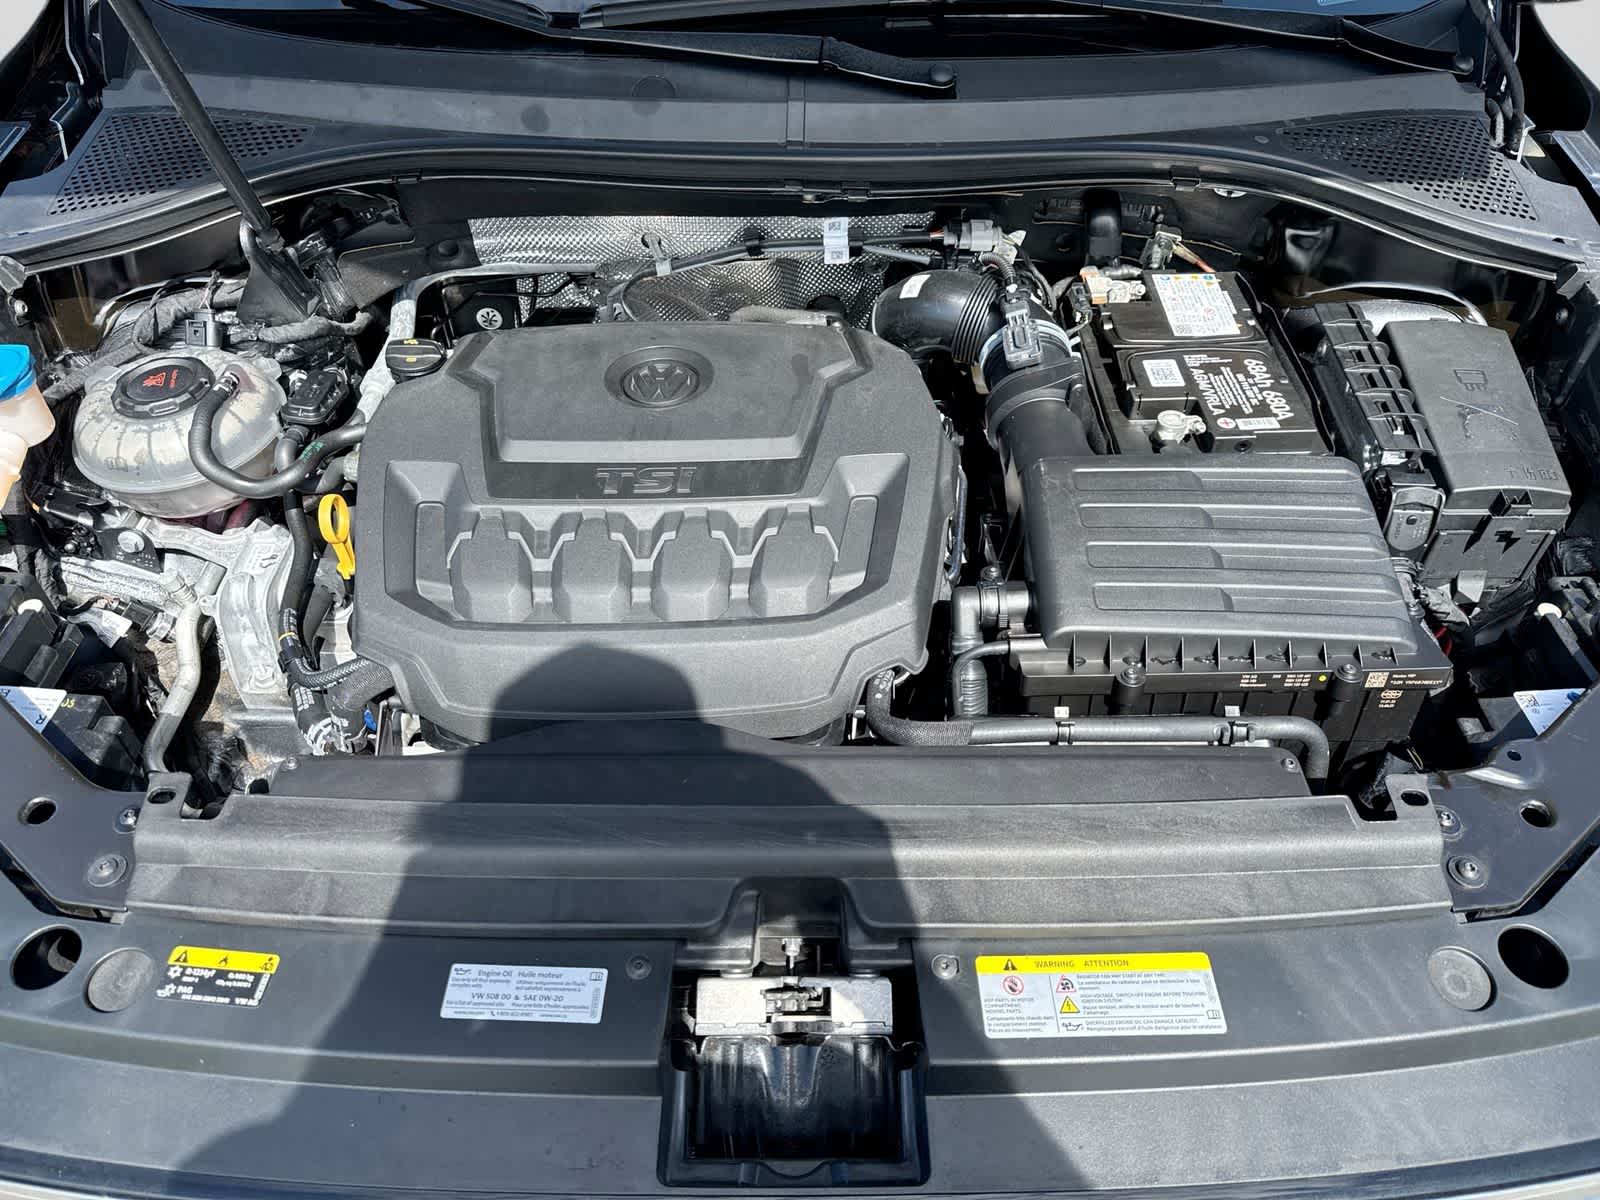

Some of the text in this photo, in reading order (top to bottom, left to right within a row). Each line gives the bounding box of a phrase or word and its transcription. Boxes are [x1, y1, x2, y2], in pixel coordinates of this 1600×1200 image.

[1243, 359, 1275, 388] 68Ah
[1262, 390, 1295, 420] 680A
[596, 467, 697, 494] TSI
[1034, 958, 1129, 968] WARNING ATTENTION
[478, 969, 513, 978] Engine Oil
[518, 970, 563, 979] Huile moteur
[501, 993, 512, 1001] 00
